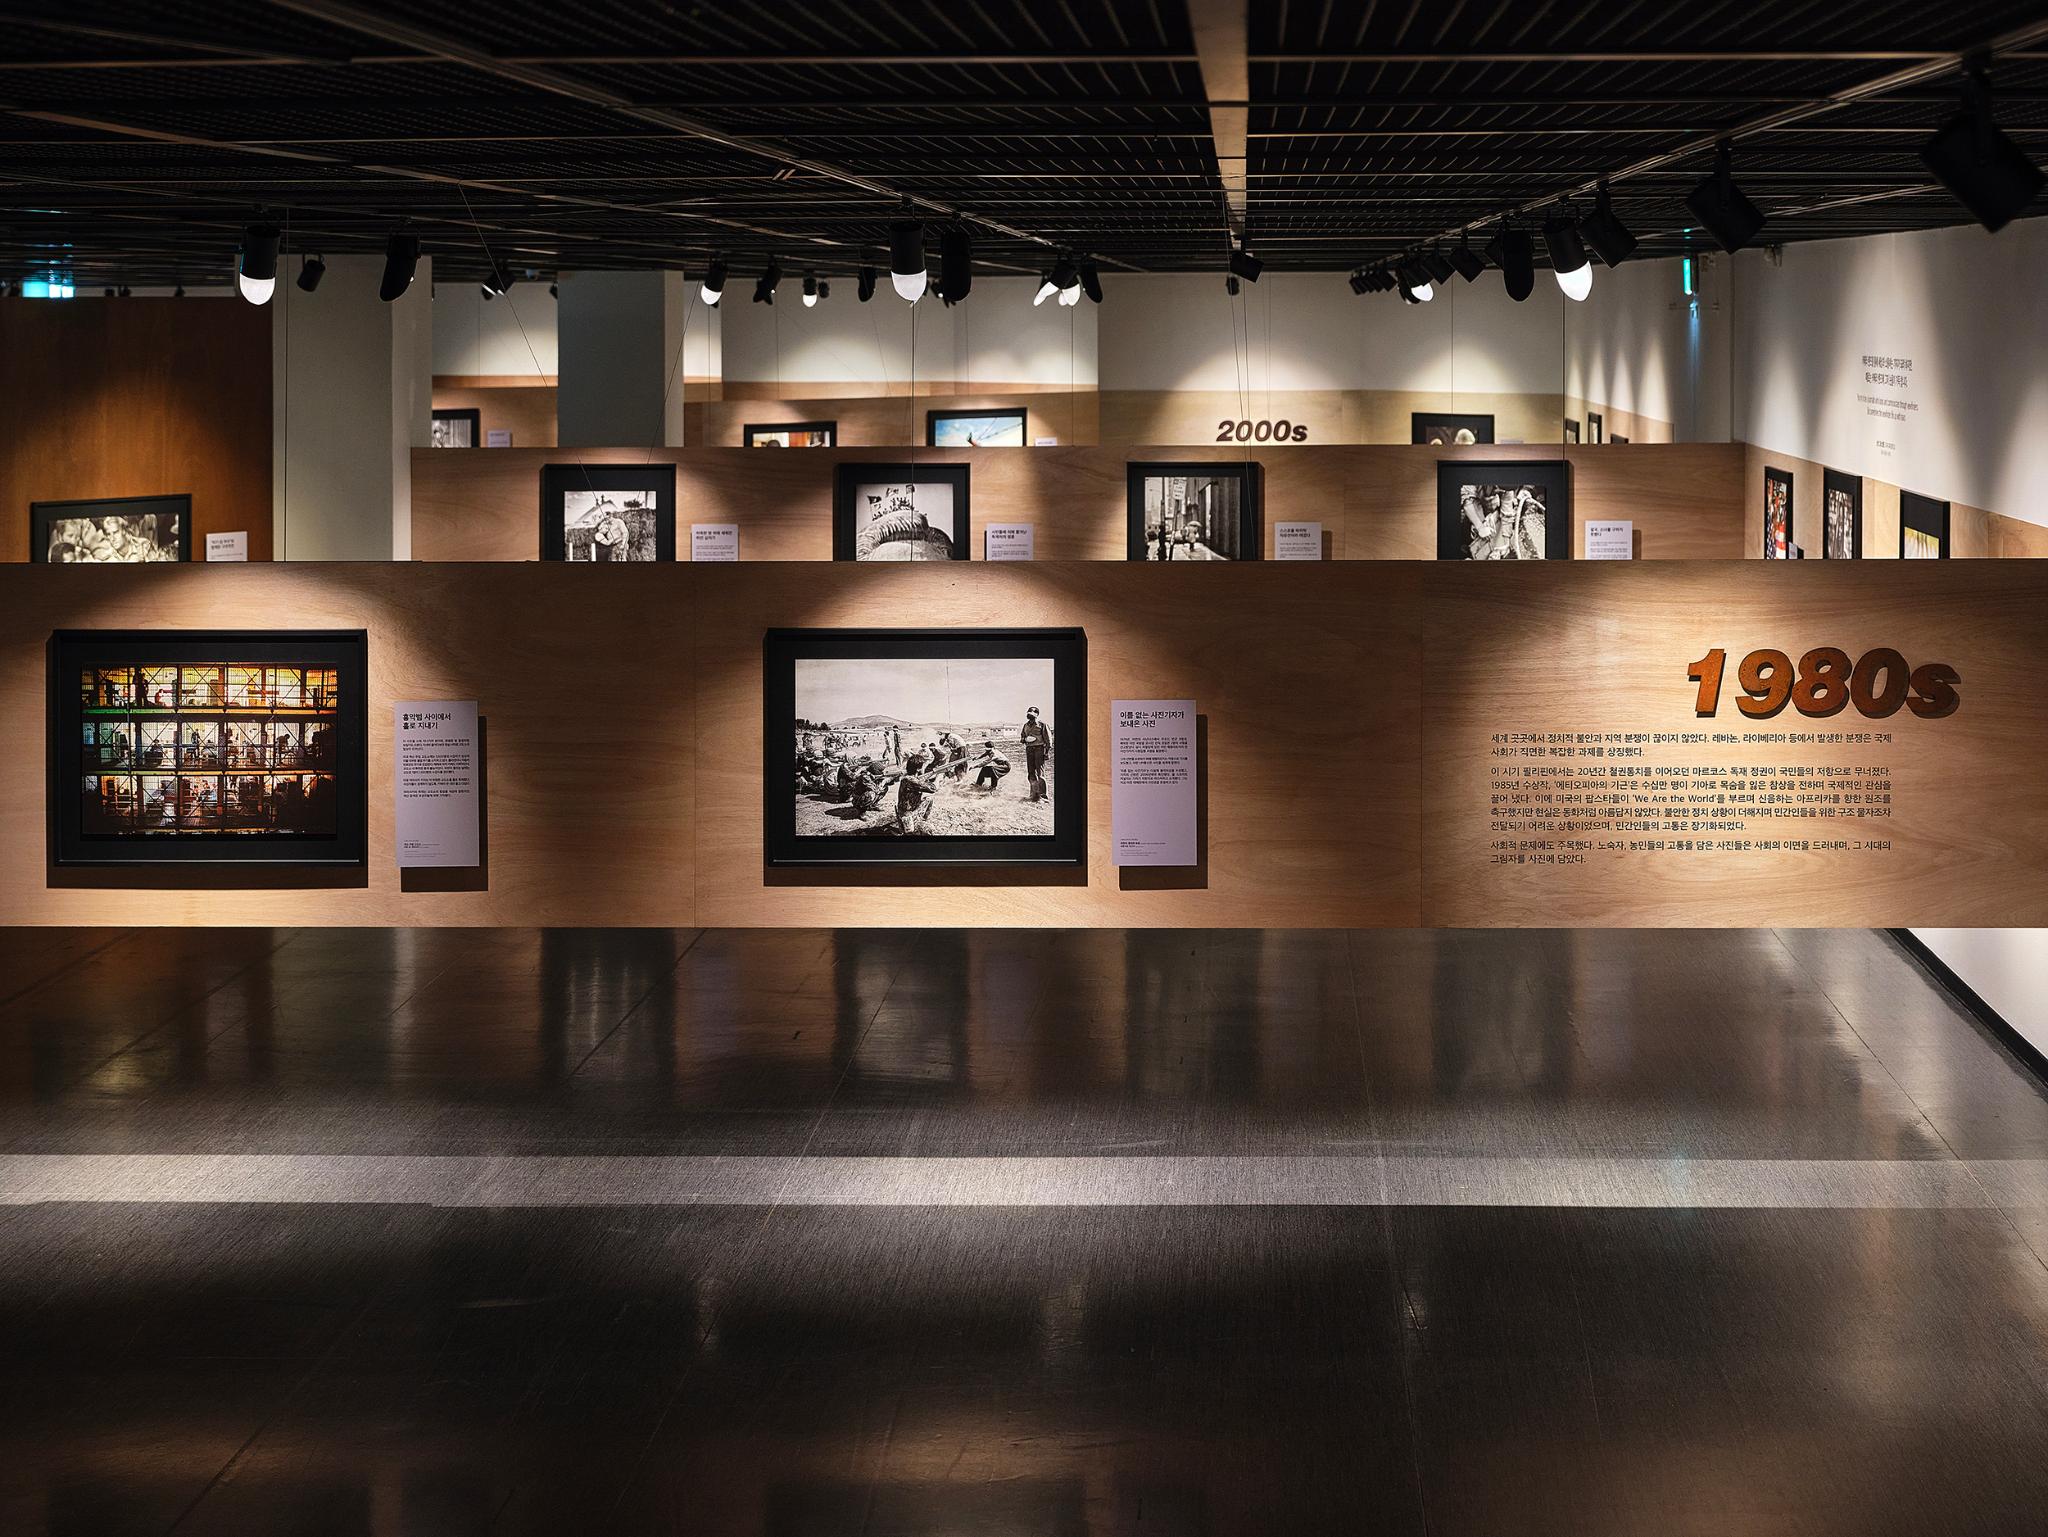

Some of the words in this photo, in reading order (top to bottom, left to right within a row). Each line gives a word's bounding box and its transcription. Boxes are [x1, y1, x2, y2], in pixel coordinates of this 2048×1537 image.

[1216, 419, 1308, 442] 2000s
[1688, 646, 1962, 719] 1980s
[1120, 711, 1133, 719] 이름
[1135, 711, 1149, 719] 없는
[1150, 711, 1184, 719] 사진기자가
[1120, 720, 1140, 728] 보내온
[1490, 733, 1508, 744] 세계
[1511, 733, 1544, 744] 곳곳에서
[1547, 733, 1573, 744] 정치적
[1576, 733, 1602, 744] 불안과
[1604, 733, 1622, 744] 지역
[1624, 733, 1650, 744] 분쟁이
[1653, 733, 1678, 744] 끊이지
[1682, 733, 1709, 744] 않았다.
[1712, 733, 1740, 744] 레바논,
[1743, 733, 1786, 744] 라이베리아
[1788, 733, 1814, 744] 등에서
[1817, 733, 1843, 744] 발생한
[1845, 733, 1871, 744] 분쟁은
[1874, 733, 1891, 744] 국제
[1490, 747, 1517, 757] 사회가
[1519, 747, 1545, 757] 직면한
[1548, 747, 1575, 757] 복잡한
[1577, 747, 1604, 757] 과제를
[1606, 747, 1644, 757] 상징했다.
[1490, 766, 1499, 777] 이
[1502, 766, 1519, 777] 시기
[1524, 766, 1575, 777] 필리핀에서는
[1578, 766, 1606, 777] 20년간
[1608, 766, 1652, 777] 철권통치를
[1655, 766, 1689, 777] 이어오던
[1692, 766, 1727, 777] 마르코스
[1731, 766, 1747, 777] 독재
[1751, 766, 1775, 777] 정권이
[1778, 766, 1813, 777] 국민들의
[1816, 766, 1851, 777] 저항으로
[1853, 766, 1891, 777] 무너졌다.
[1491, 780, 1519, 790] 1985년
[1522, 780, 1551, 790] 수상작,
[1641, 780, 1668, 790] 수십만
[1670, 780, 1687, 790] 명이
[1690, 780, 1716, 790] 기아로
[1721, 780, 1746, 790] 목숨을
[1770, 780, 1794, 790] 참상을
[1797, 780, 1824, 790] 전하며
[1827, 780, 1862, 790] 국제적인
[1864, 780, 1891, 790] 관심을
[1536, 794, 1552, 804] 이에
[1556, 794, 1582, 804] 미국의
[1584, 794, 1630, 804] 팝스타들이
[1652, 794, 1668, 804] Are
[1670, 794, 1685, 804] the
[1729, 794, 1754, 804] 부르며
[1756, 794, 1793, 804] 신음하는
[1796, 794, 1840, 804] 아프리카를
[1844, 794, 1862, 804] 향한
[1864, 794, 1891, 804] 원조를
[1490, 807, 1533, 817] 촉구했지만
[1535, 807, 1561, 817] 현실은
[1564, 807, 1596, 817] 동화처럼
[1598, 807, 1632, 817] 아름답지
[1634, 807, 1662, 817] 않았다.
[1664, 807, 1690, 817] 불안한
[1692, 807, 1708, 817] 정치
[1711, 807, 1736, 817] 상황이
[1738, 807, 1771, 817] 더해지며
[1774, 807, 1816, 817] 민간인들을
[1819, 807, 1835, 817] 위한
[1838, 807, 1855, 817] 구조
[1858, 807, 1891, 817] 물자조차
[1490, 821, 1525, 831] 전달되기
[1528, 821, 1554, 831] 어려운
[1557, 821, 1613, 831] 상황이었으며,
[1615, 821, 1659, 831] 민간인들의
[1662, 821, 1689, 831] 고통은
[1692, 821, 1746, 831] 장기화되었다.
[1490, 840, 1516, 850] 사회적
[1519, 840, 1555, 850] 문제에도
[1557, 840, 1596, 850] 주목했다.
[1599, 840, 1628, 850] 노숙자,
[1630, 840, 1664, 850] 농민들의
[1667, 840, 1694, 850] 고통을
[1697, 840, 1713, 850] 담은
[1716, 840, 1751, 850] 사진들은
[1754, 840, 1780, 850] 사회의
[1783, 840, 1809, 850] 이면을
[1812, 840, 1850, 850] 드러내며,
[1853, 840, 1862, 850] 그
[1864, 840, 1890, 850] 시대의
[1490, 854, 1525, 864] 그림자를
[1528, 854, 1554, 864] 사진에
[1557, 854, 1586, 864] 담았다.
